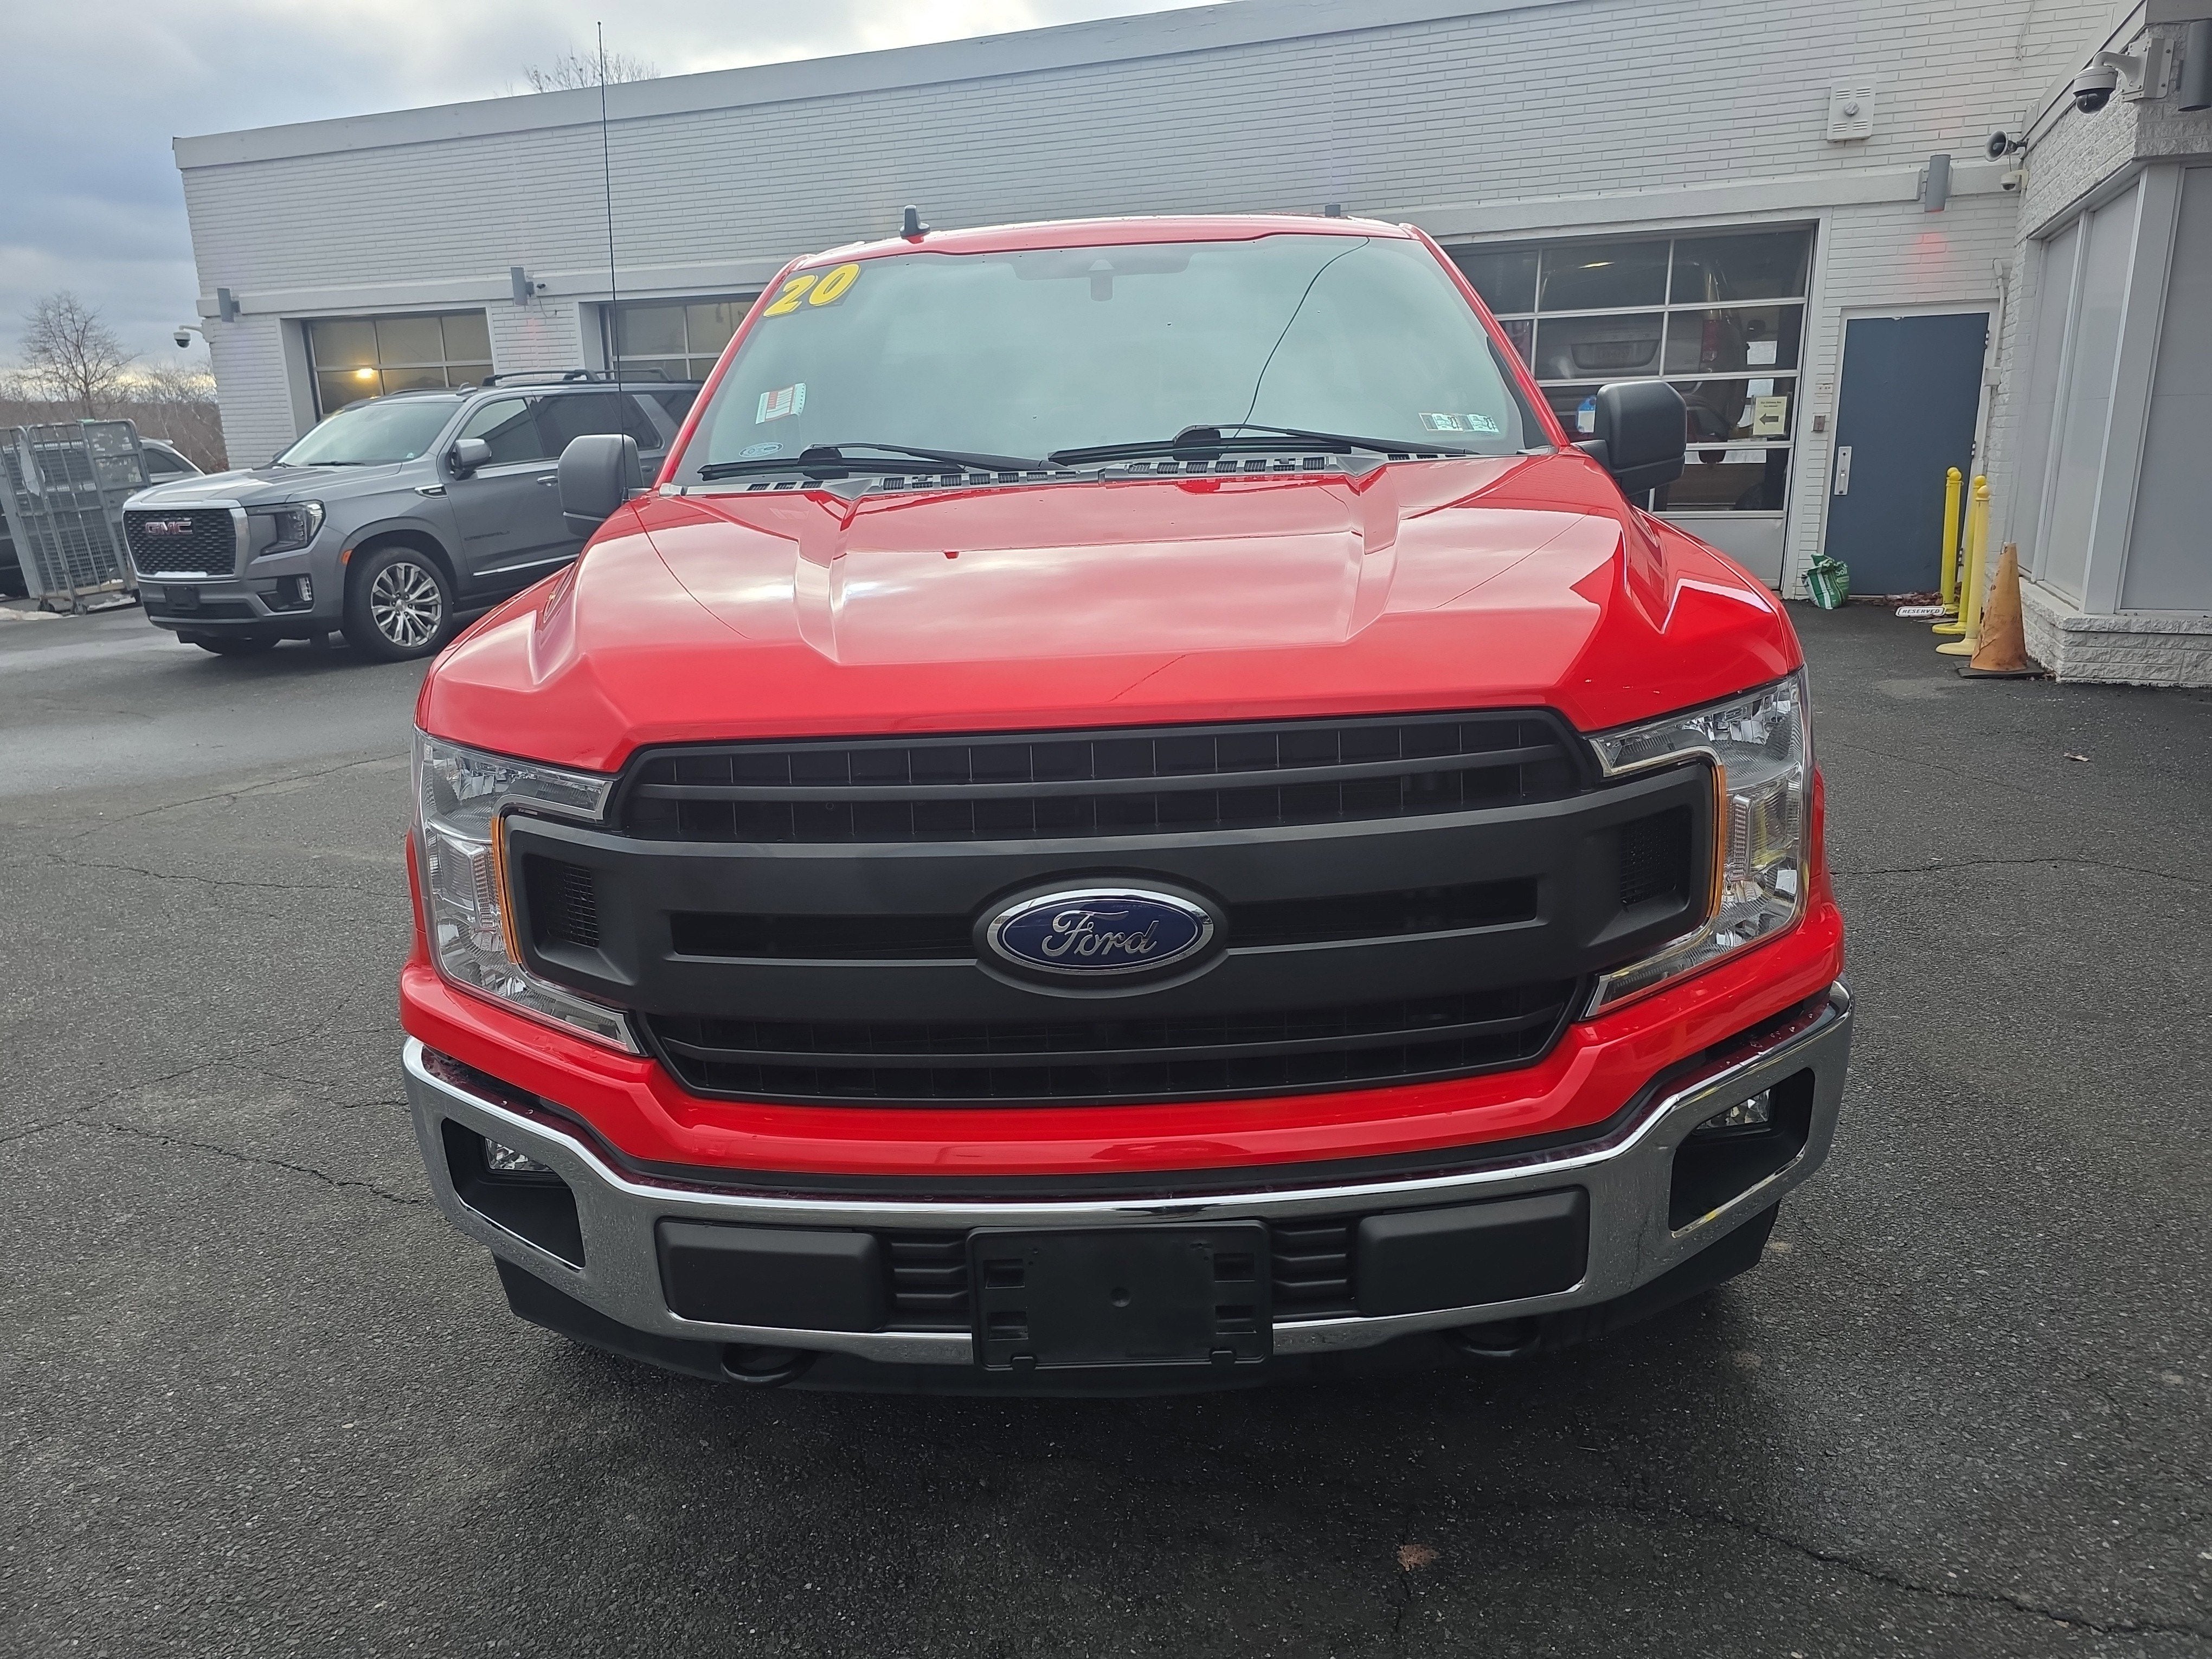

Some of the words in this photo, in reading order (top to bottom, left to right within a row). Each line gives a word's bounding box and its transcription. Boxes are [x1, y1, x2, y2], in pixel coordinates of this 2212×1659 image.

[763, 263, 861, 317] 20
[145, 521, 193, 535] GMC
[1041, 910, 1160, 957] Ford
